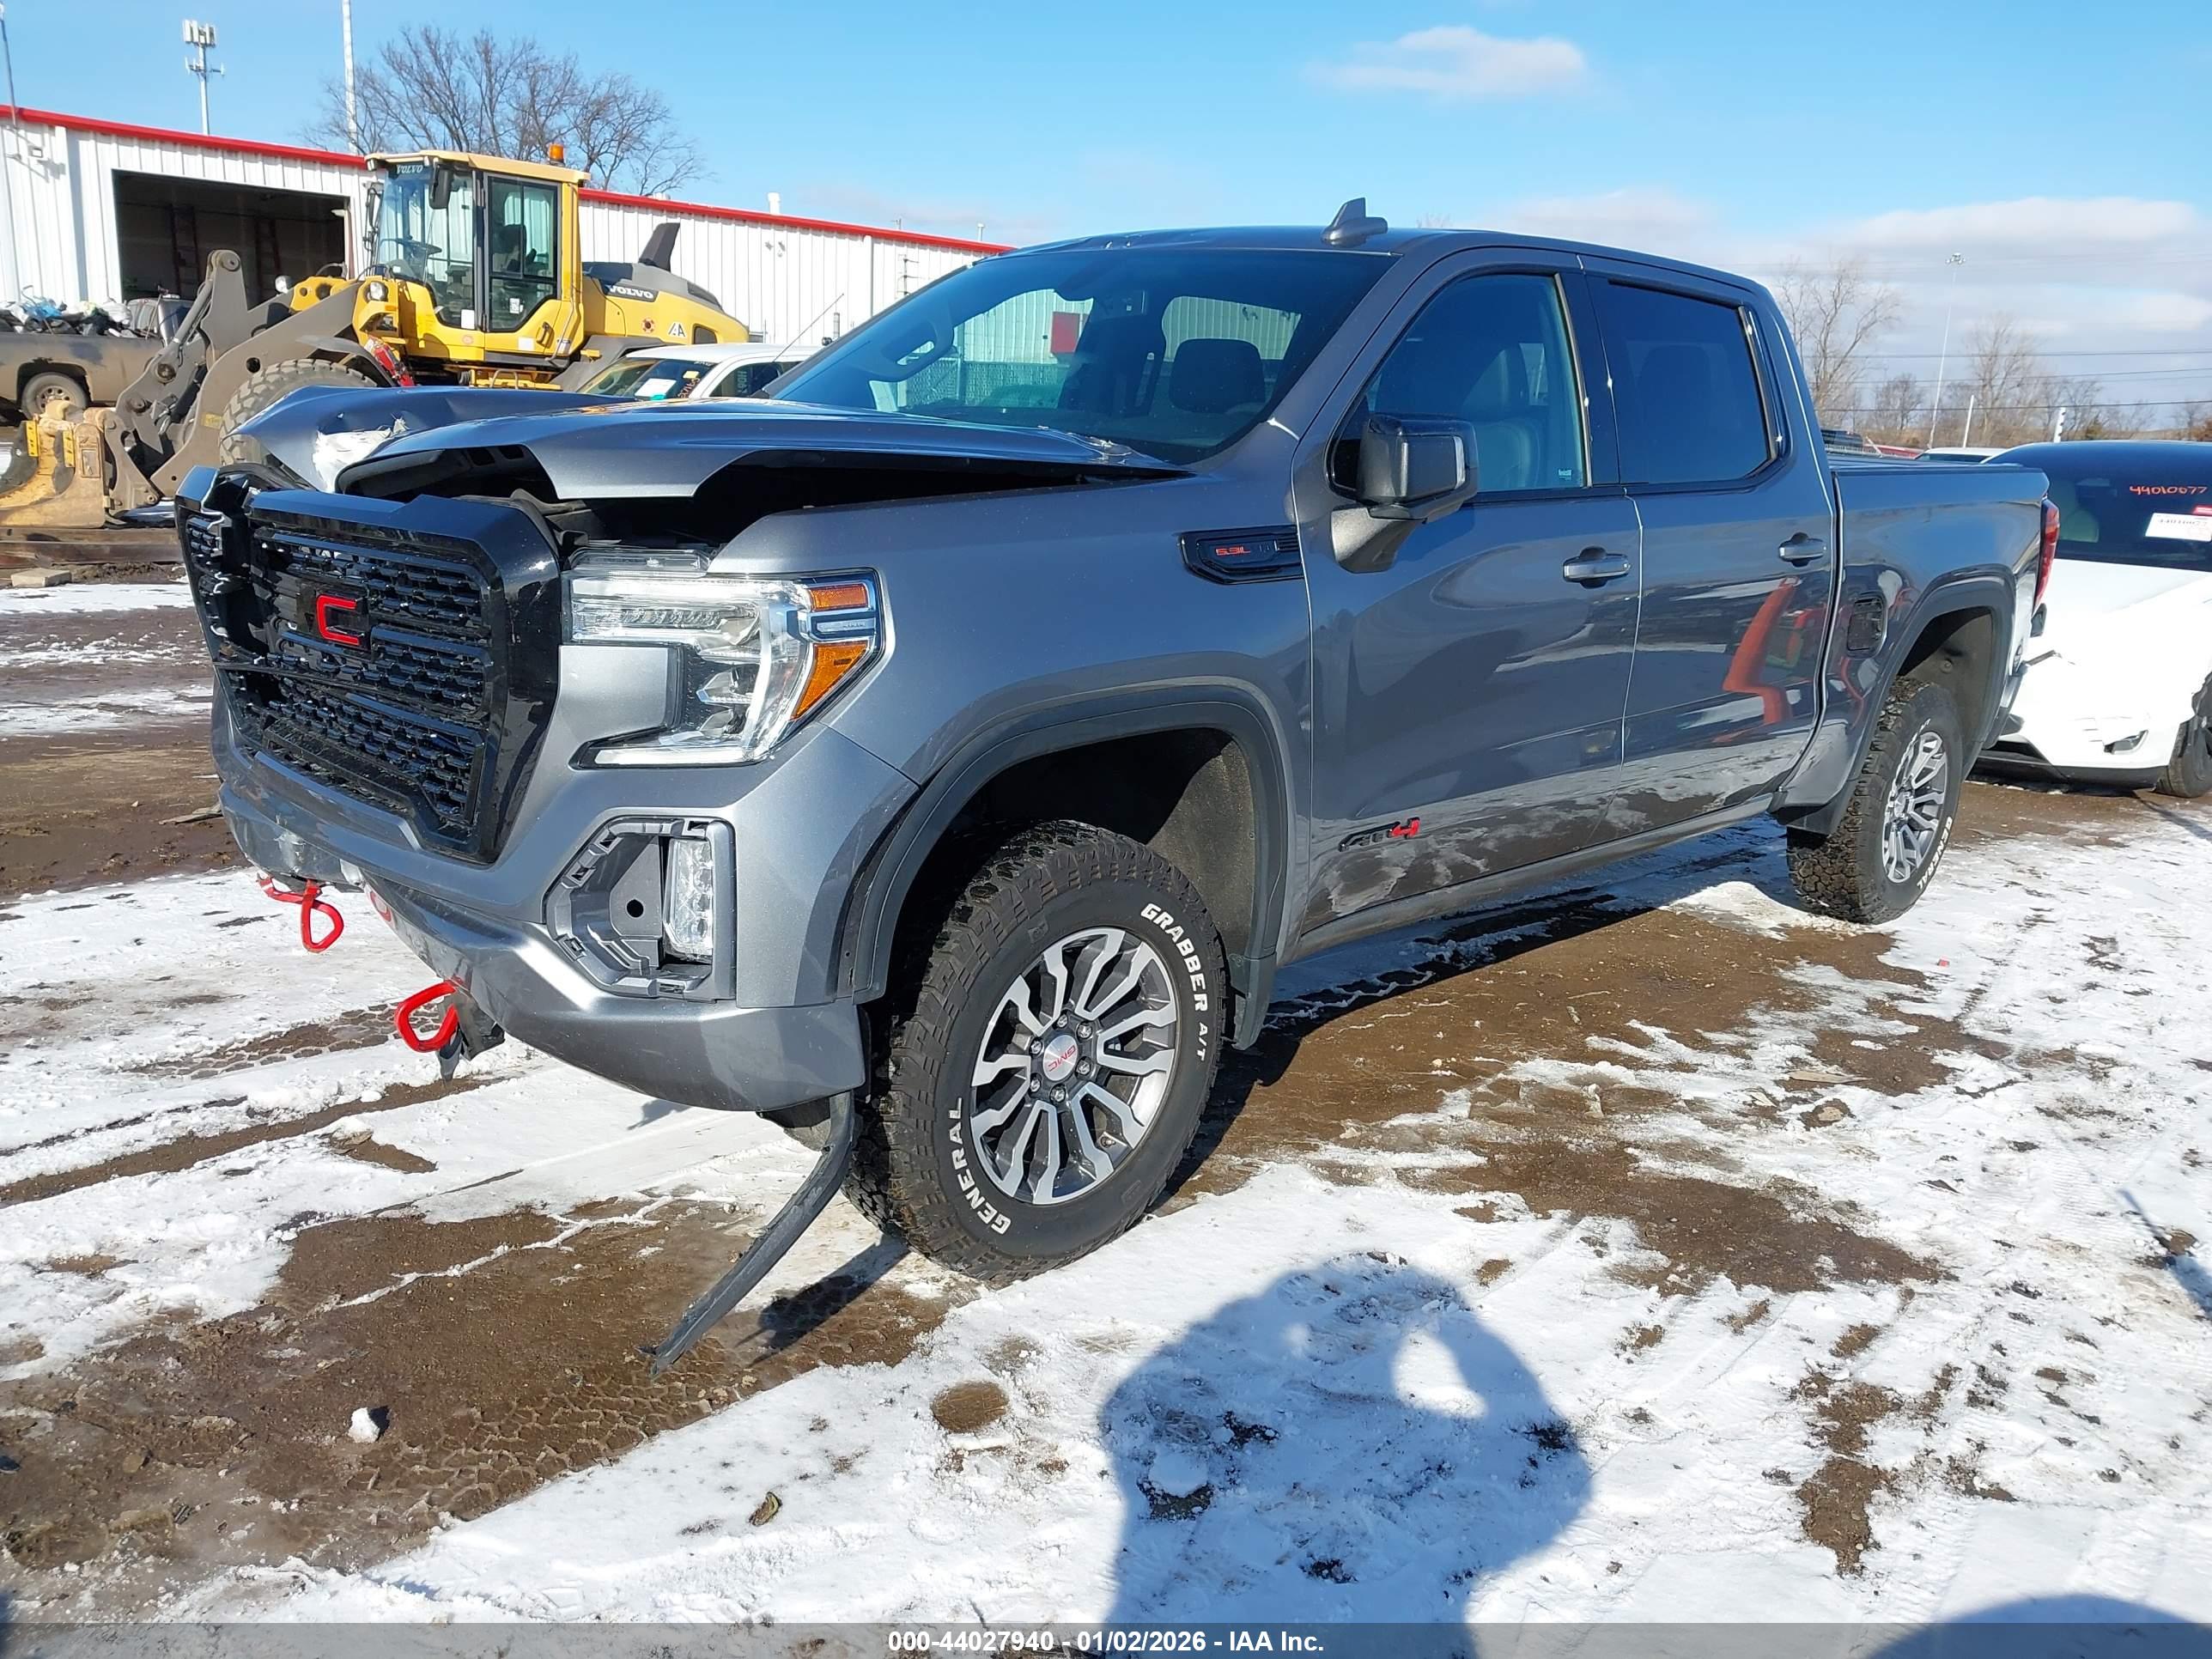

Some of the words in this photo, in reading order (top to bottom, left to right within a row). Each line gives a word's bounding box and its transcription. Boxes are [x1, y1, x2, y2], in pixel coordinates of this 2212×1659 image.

[397, 164, 423, 174] VOLVO
[605, 285, 654, 299] VOLVO
[2129, 485, 2208, 495] 44010077
[1916, 816, 1954, 890] GENERAL
[1140, 902, 1209, 1012] GRABBER
[1196, 1022, 1208, 1061] A/T
[1048, 1044, 1077, 1073] GMC
[948, 1097, 1012, 1235] GENERAL
